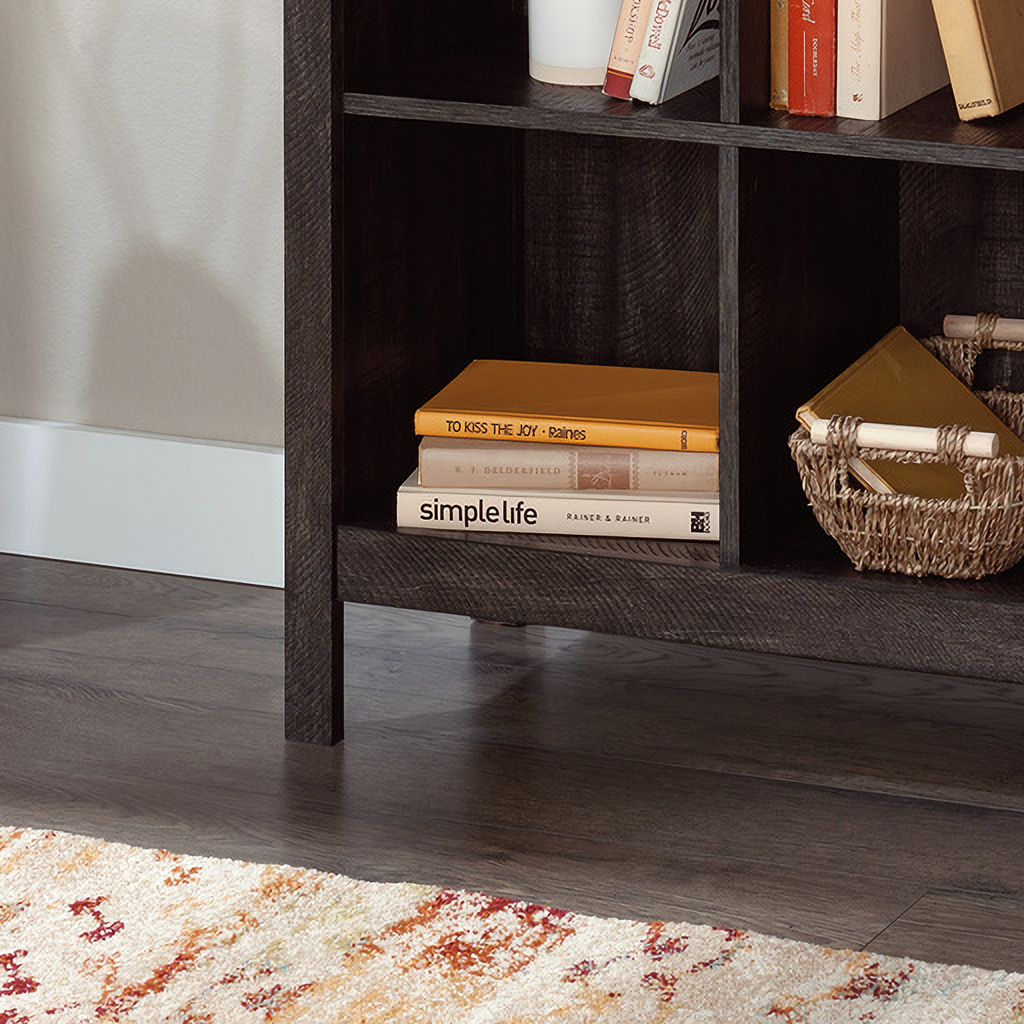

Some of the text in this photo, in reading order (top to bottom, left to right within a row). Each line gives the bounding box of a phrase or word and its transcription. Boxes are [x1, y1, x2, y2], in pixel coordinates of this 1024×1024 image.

[446, 420, 461, 432] TO
[464, 421, 488, 434] KISS
[491, 423, 513, 436] THE
[516, 424, 538, 437] JOY
[566, 512, 602, 522] RAINER
[615, 515, 651, 524] RAINER
